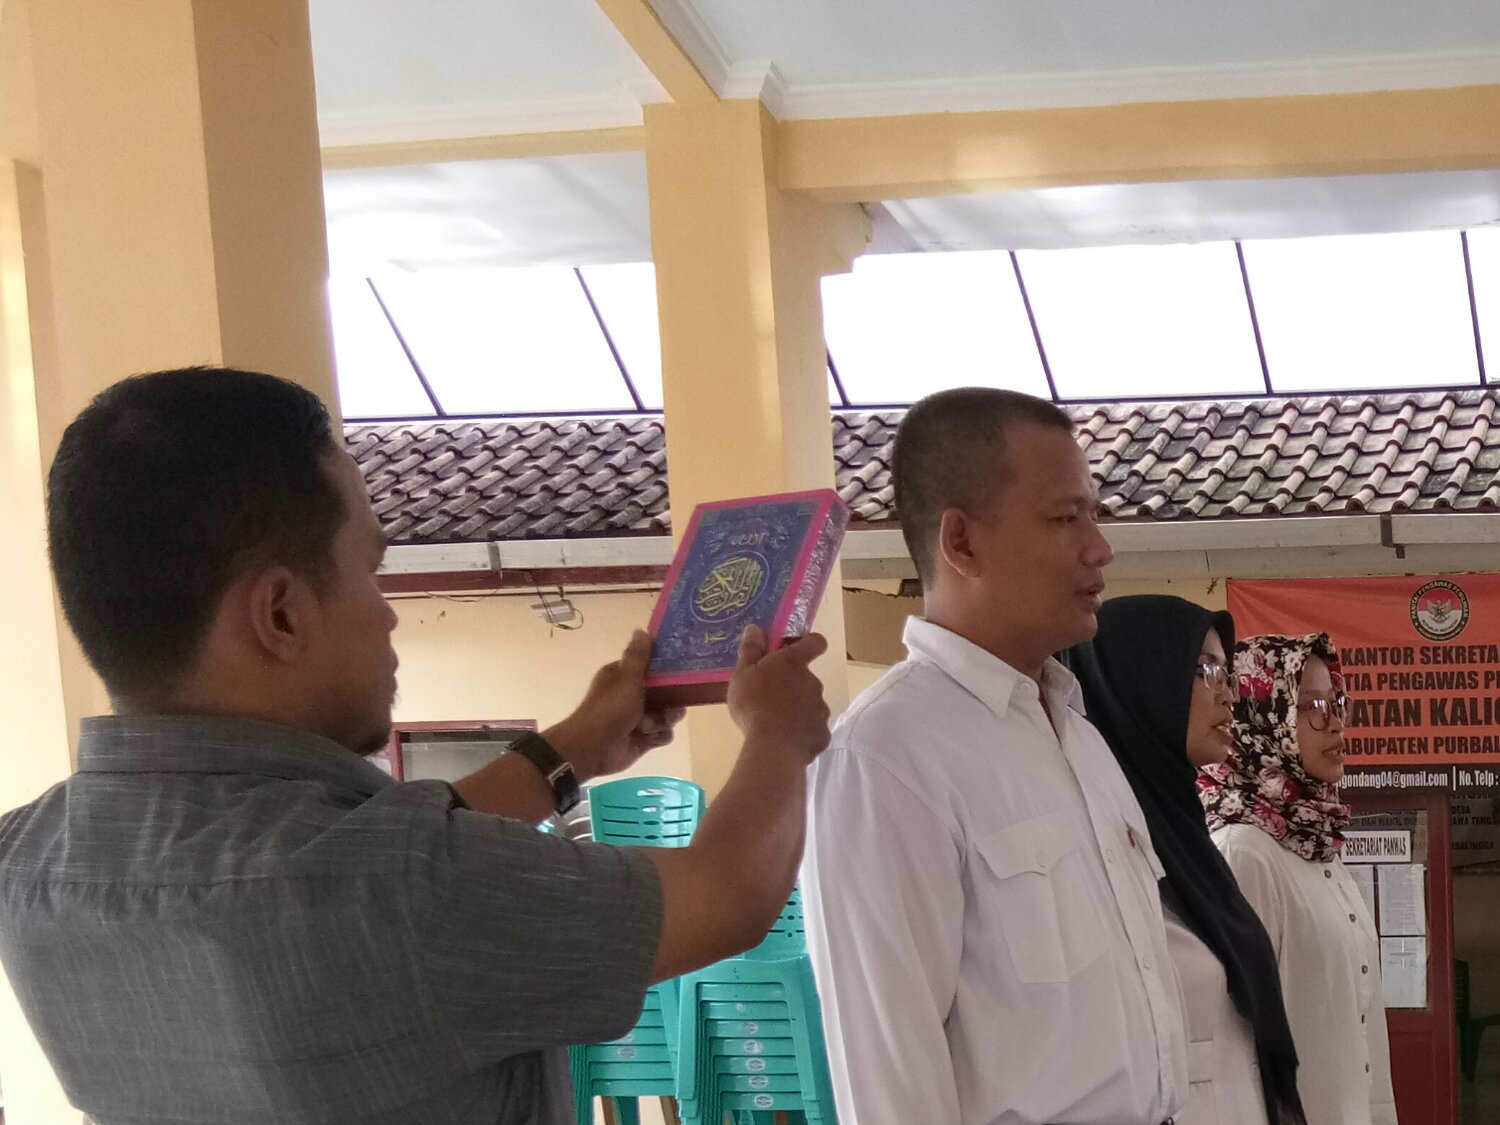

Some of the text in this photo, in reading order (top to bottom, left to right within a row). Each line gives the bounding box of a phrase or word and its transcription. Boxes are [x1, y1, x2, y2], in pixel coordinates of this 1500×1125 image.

[1341, 646, 1415, 666] KANTOR
[1377, 671, 1479, 690] PENGAWAS
[1459, 770, 1473, 787] No.
[1346, 837, 1382, 856] SEKRETARIAT
